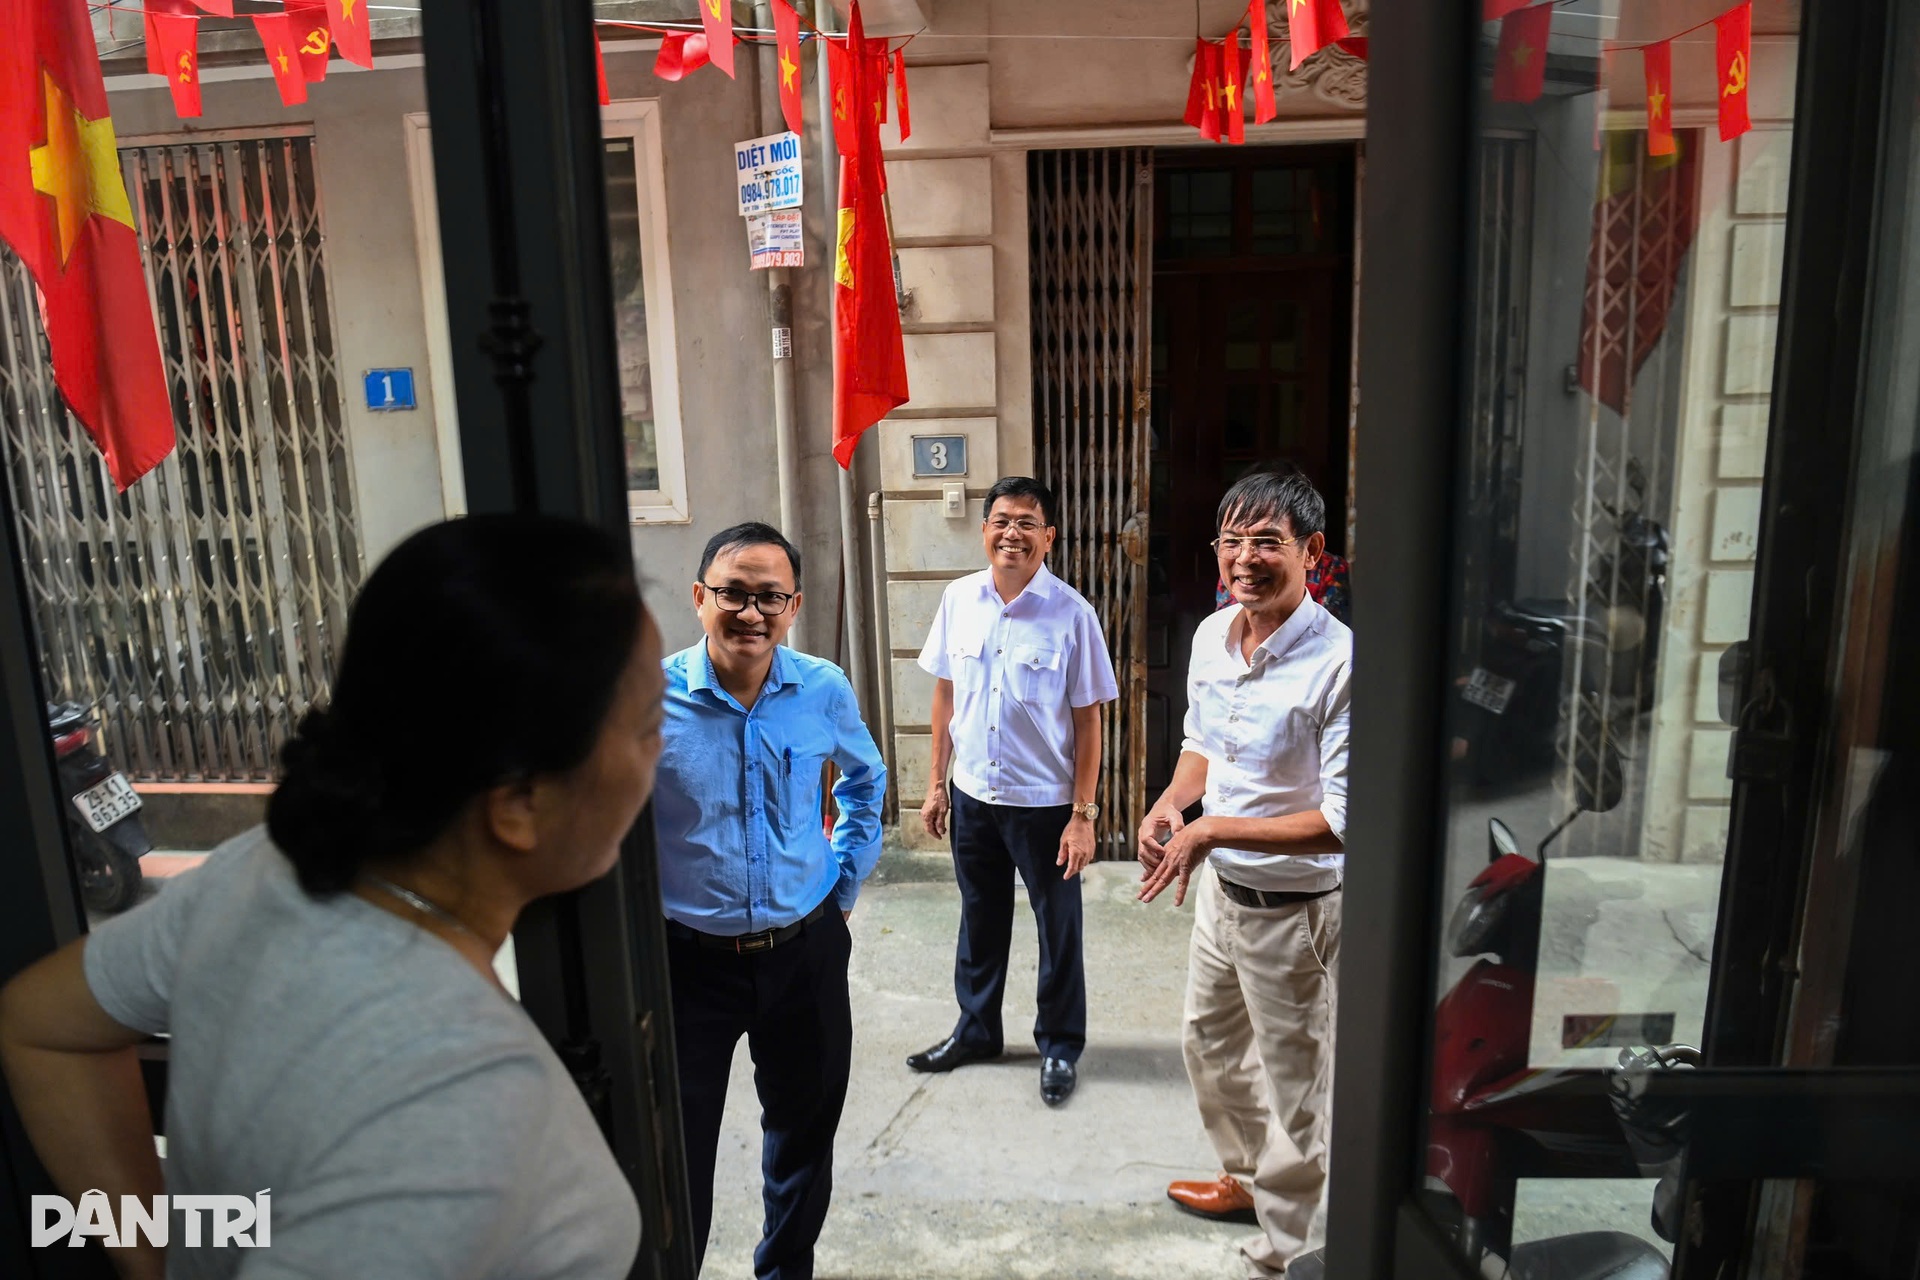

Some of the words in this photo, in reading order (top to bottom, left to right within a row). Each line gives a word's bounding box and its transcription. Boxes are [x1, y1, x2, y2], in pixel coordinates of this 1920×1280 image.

[737, 143, 765, 171] DIỆT
[770, 132, 797, 163] MỐI
[775, 165, 795, 175] GỐC
[741, 174, 800, 204] 0984.978.017
[381, 375, 395, 402] 1
[930, 442, 948, 469] 3
[91, 791, 138, 827] 963.35
